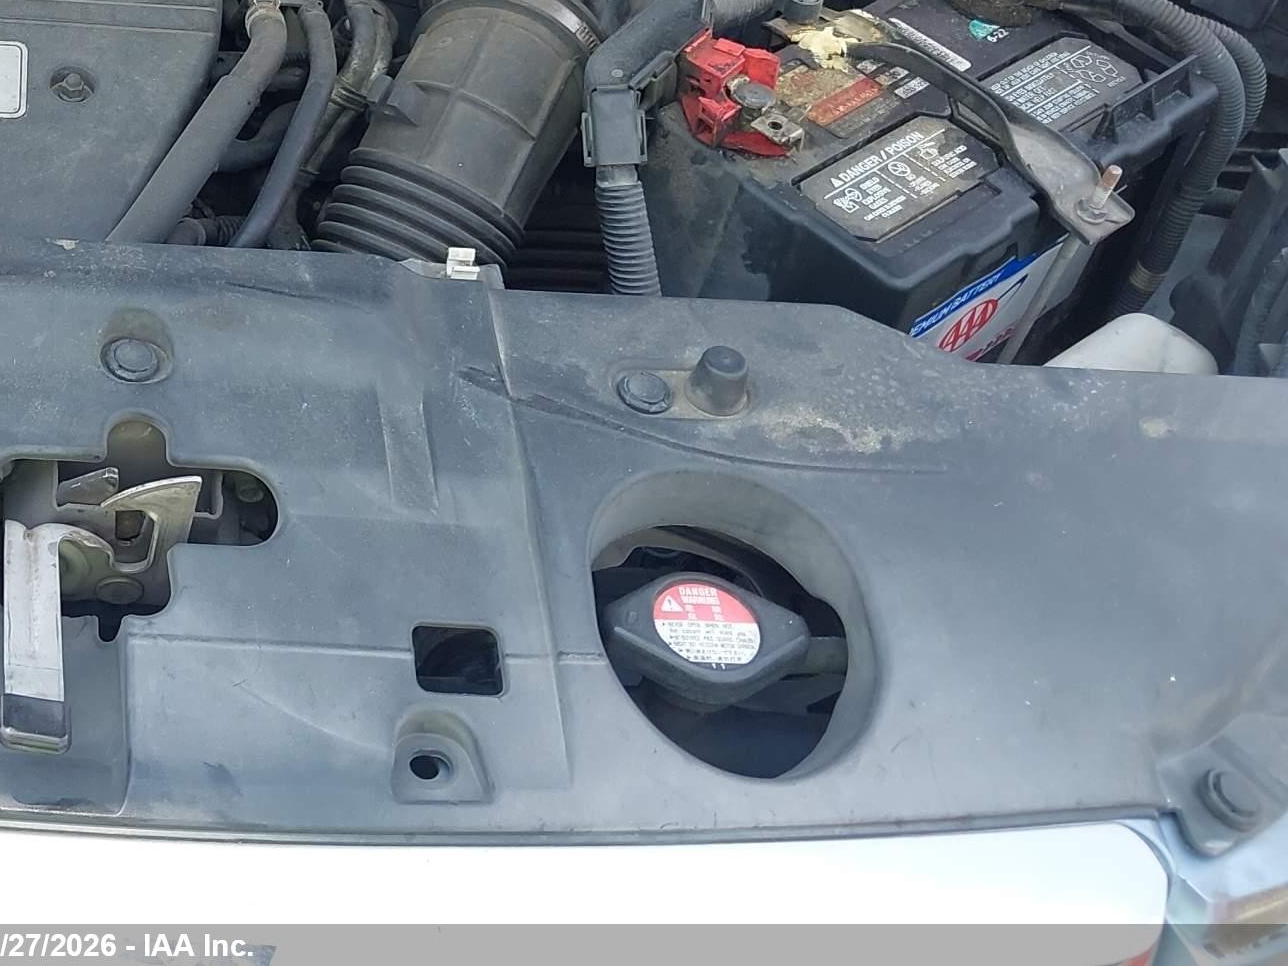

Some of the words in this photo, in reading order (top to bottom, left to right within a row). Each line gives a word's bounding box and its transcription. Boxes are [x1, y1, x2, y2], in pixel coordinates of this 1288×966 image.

[838, 155, 883, 183] DANGER
[884, 131, 925, 156] POISON
[678, 585, 718, 597] DANGER
